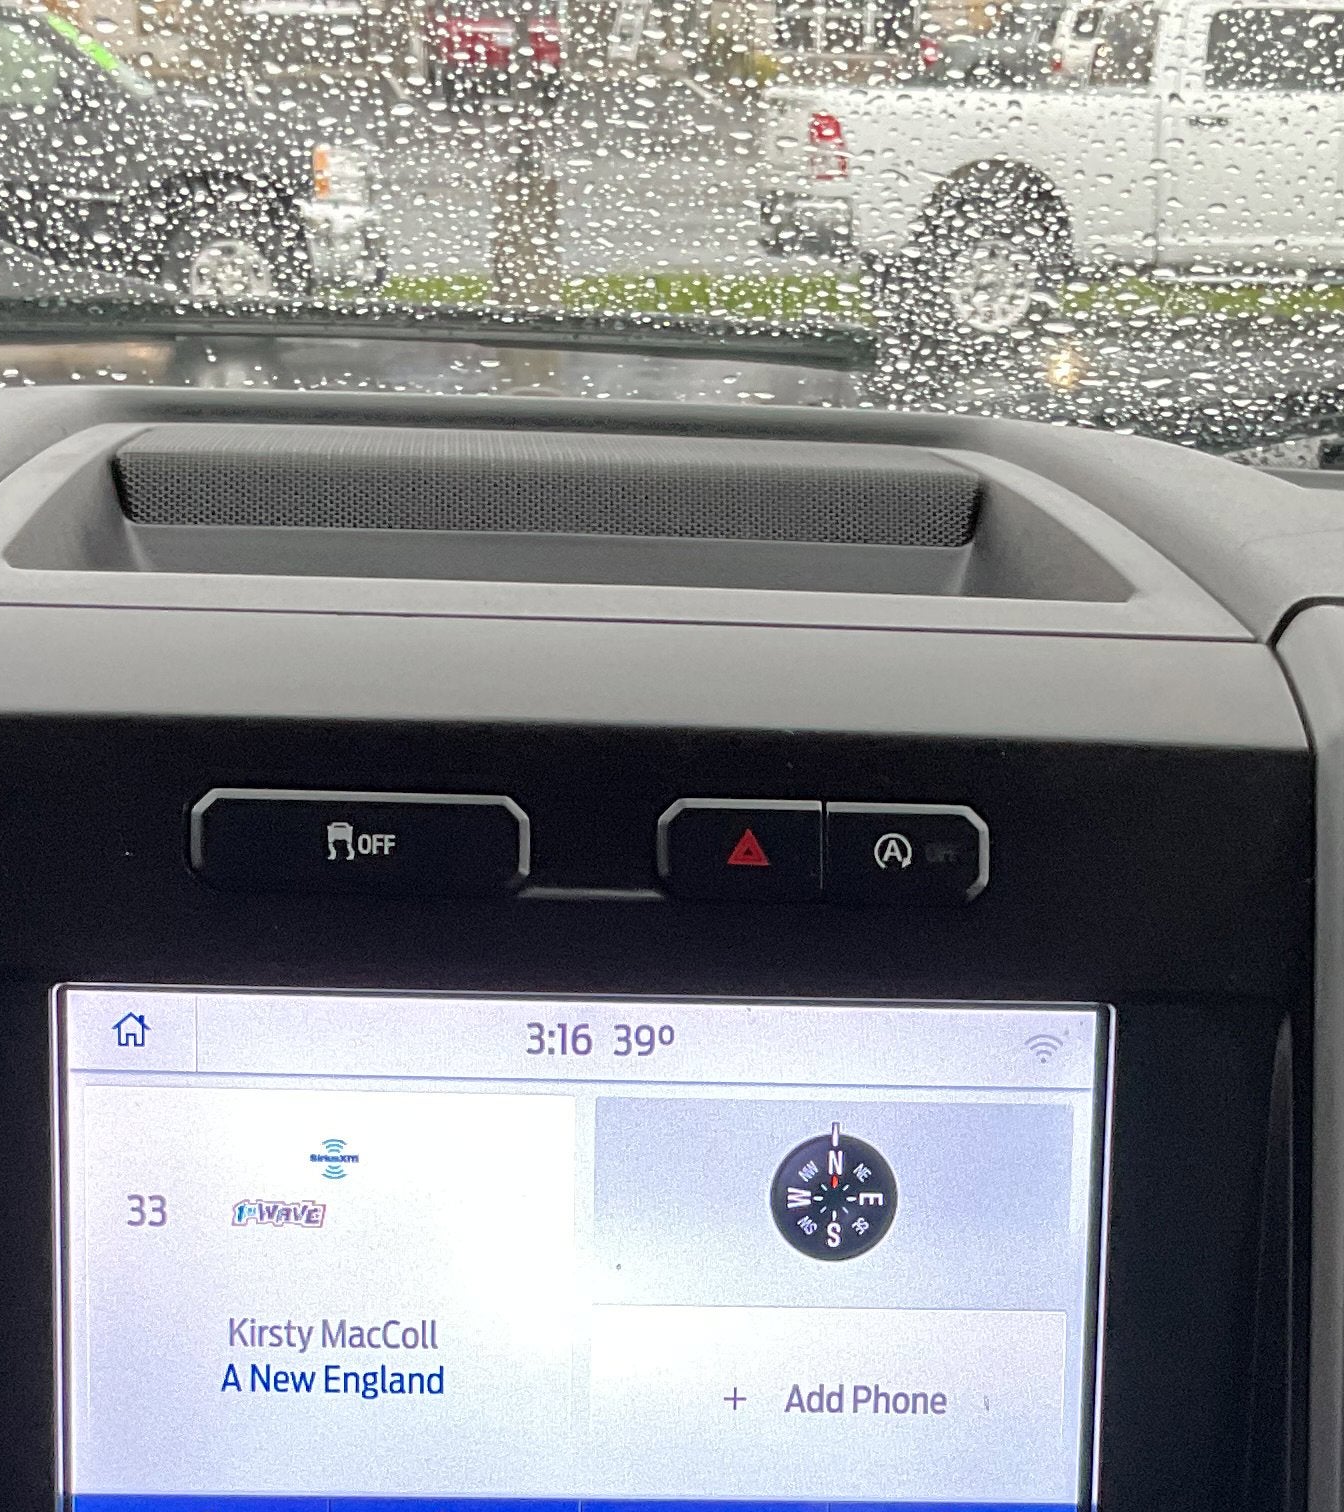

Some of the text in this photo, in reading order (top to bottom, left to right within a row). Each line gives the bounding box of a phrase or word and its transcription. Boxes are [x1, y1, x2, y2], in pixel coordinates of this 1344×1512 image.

[356, 832, 396, 857] OFF
[527, 1023, 592, 1055] 3:16
[828, 1150, 844, 1176] N
[127, 1194, 168, 1228] 33
[787, 1186, 812, 1209] W
[858, 1192, 884, 1206] E
[826, 1222, 841, 1248] S
[229, 1318, 438, 1353] Kirsty MacColl
[221, 1364, 444, 1399] A New England
[785, 1384, 947, 1414] Add Phone
